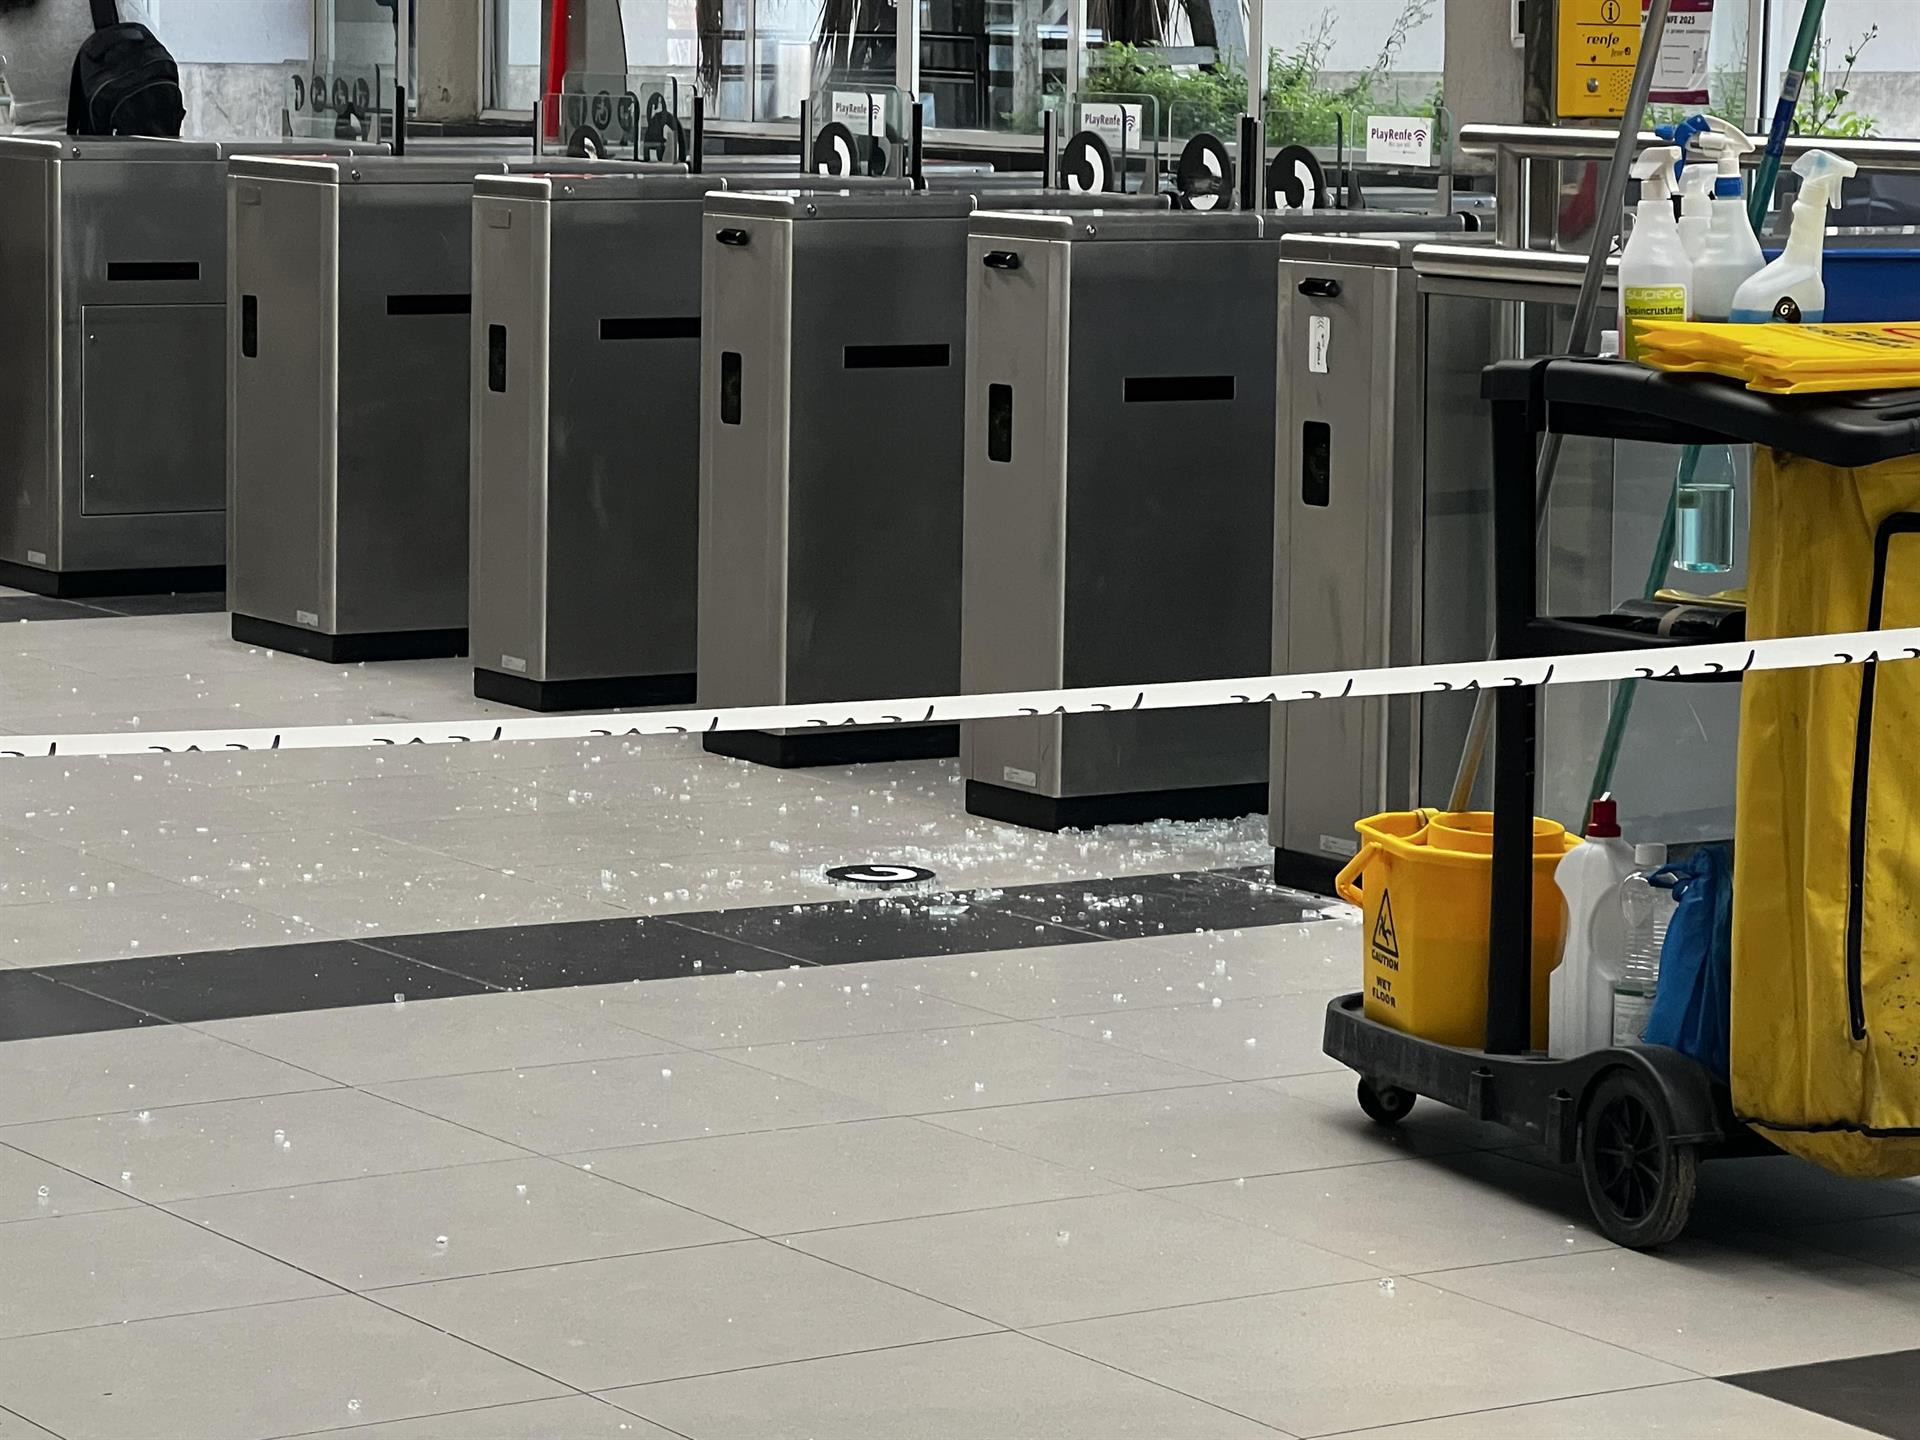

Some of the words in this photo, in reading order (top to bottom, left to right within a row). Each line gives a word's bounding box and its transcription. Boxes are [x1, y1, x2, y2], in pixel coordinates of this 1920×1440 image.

[1679, 15, 1695, 25] 2025
[1586, 32, 1620, 48] renfe
[835, 102, 867, 115] PlayRenfe
[1085, 113, 1121, 127] PlayRenfe
[1371, 127, 1413, 142] PlayRenfe
[1625, 289, 1684, 301] supera
[1371, 948, 1399, 972] CAUTION
[1376, 975, 1392, 992] WET
[1372, 987, 1396, 1008] FLOOR
